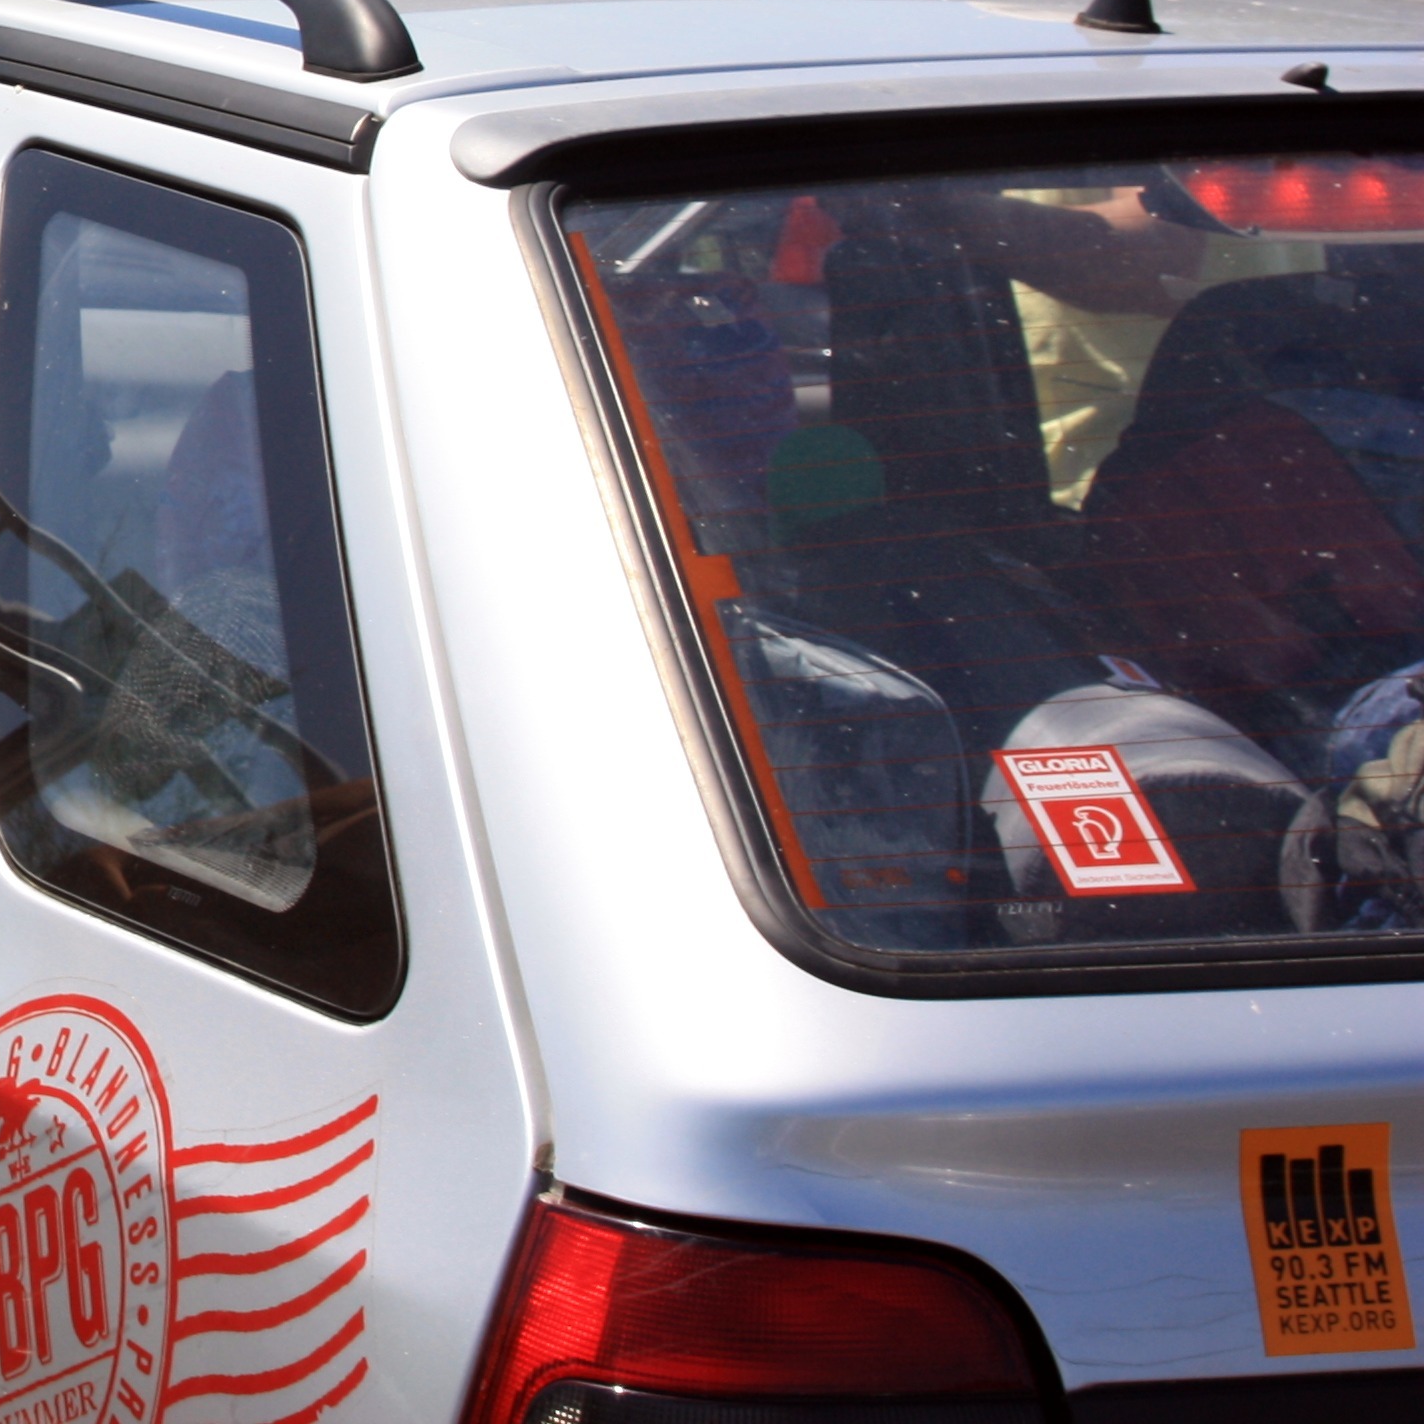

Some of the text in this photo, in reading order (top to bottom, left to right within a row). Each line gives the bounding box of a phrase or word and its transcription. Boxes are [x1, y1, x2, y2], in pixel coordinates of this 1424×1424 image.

[1017, 756, 1108, 774] GLORIA
[1026, 779, 1121, 792] Feuerlöscher
[45, 1027, 160, 1285] BLANDNESS
[1268, 1217, 1376, 1247] KEXP
[1270, 1251, 1388, 1281] 90.3 FM
[1275, 1280, 1393, 1309] SEATTLE
[1279, 1310, 1396, 1336] KEXP.ORG
